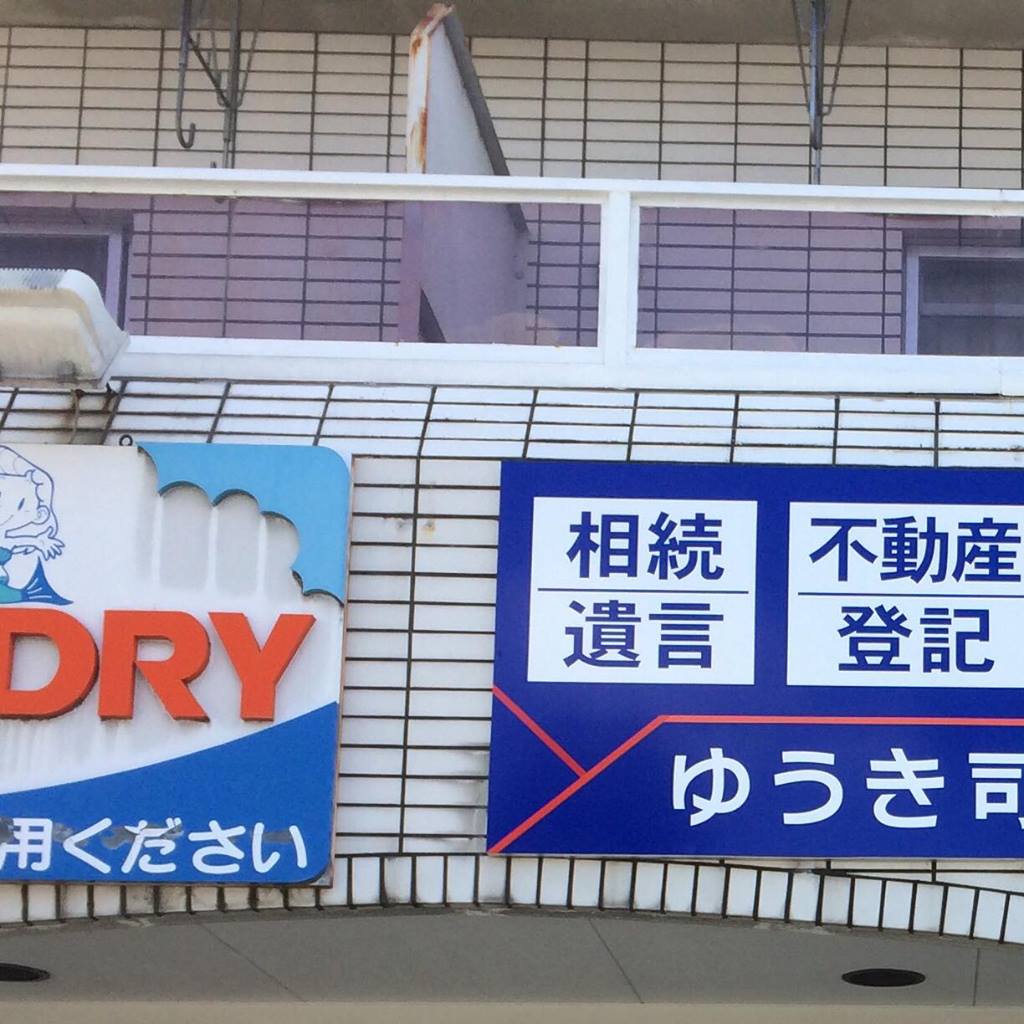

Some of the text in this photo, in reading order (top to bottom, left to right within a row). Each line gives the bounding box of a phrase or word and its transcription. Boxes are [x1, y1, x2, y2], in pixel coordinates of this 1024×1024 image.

[567, 511, 724, 581] 相続
[809, 515, 1021, 583] 不動産
[0, 608, 317, 723] DRY
[563, 599, 724, 668] 遺言
[837, 604, 995, 673] 登記
